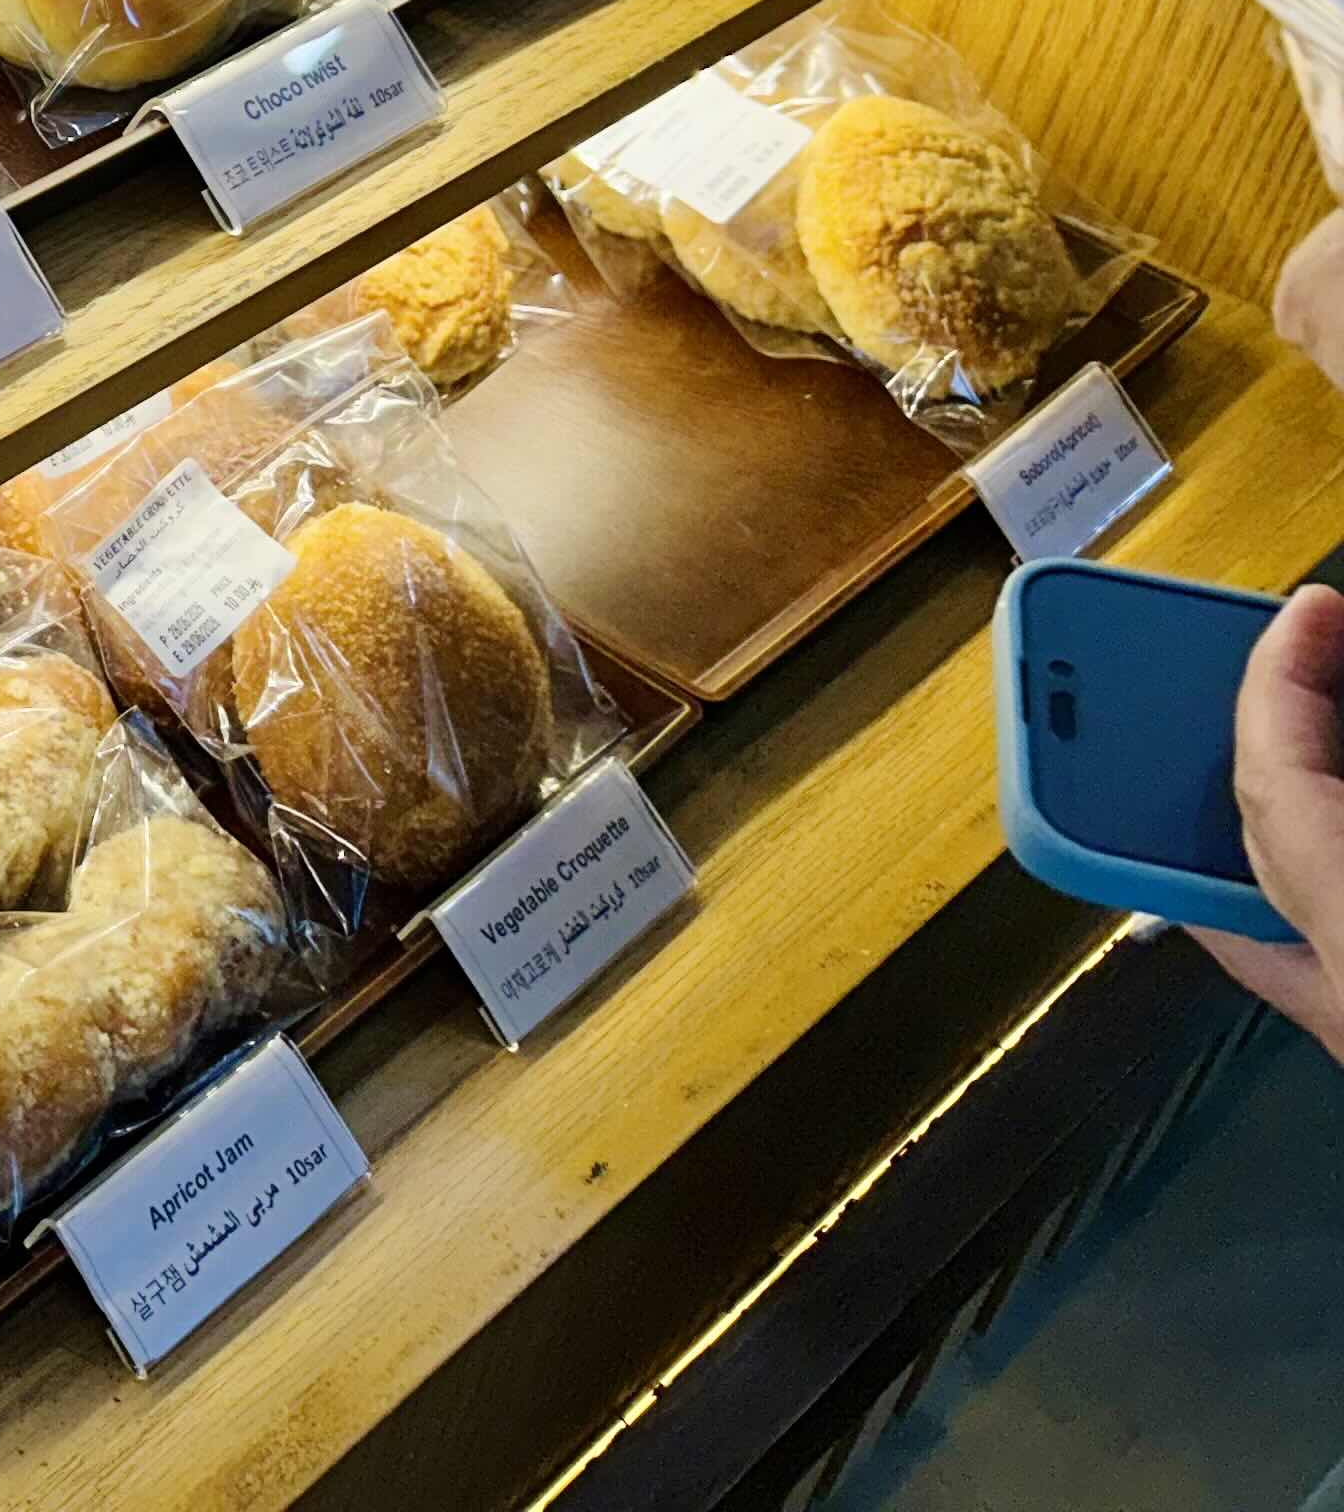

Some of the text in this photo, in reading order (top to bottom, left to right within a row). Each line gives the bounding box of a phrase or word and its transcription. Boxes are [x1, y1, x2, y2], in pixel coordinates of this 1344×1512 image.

[244, 54, 348, 121] Choco twist
[368, 80, 405, 109] 10sar
[93, 518, 144, 571] VEGETABLE
[480, 815, 631, 945] Vegetable Croquette
[628, 856, 662, 890] 10sar
[147, 1132, 256, 1231] Apricot Jam
[129, 1143, 329, 1321] 살구잼 مربى المشمش 10sar
